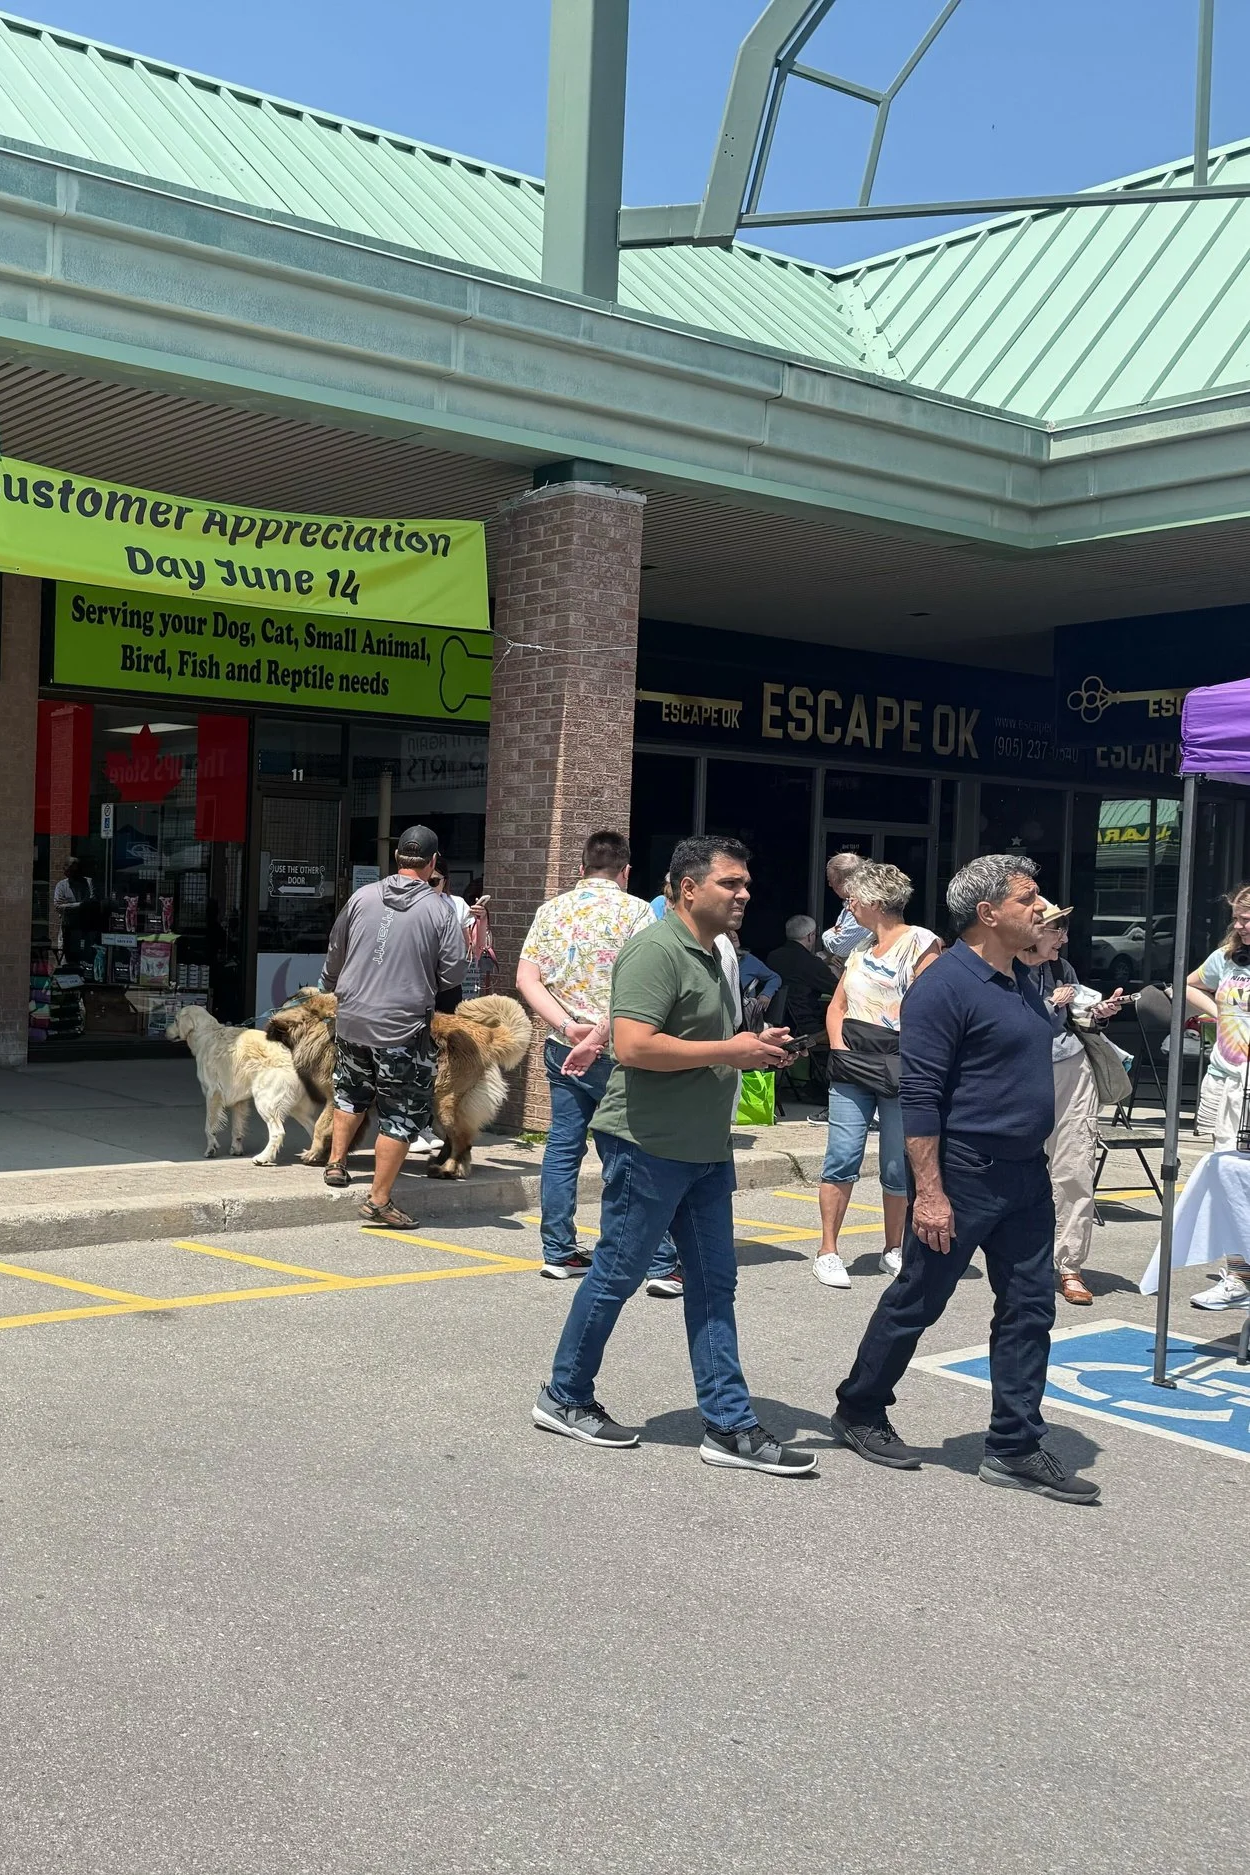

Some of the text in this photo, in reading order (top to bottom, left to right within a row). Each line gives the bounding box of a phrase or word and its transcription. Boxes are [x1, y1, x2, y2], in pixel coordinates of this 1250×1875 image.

[202, 507, 452, 559] Appreciation
[123, 545, 361, 605] Day June 14
[71, 595, 431, 666] Serving your Dog, Cat, Small Animal,
[121, 644, 389, 697] Bird, Fish and Reptile needs
[661, 700, 741, 729] ESCAPE OK
[761, 682, 982, 759] ESCAPE OK
[994, 736, 1023, 761] (905)
[1096, 743, 1180, 773] ESCAP
[291, 768, 304, 781] 11
[274, 865, 320, 875] USE THE OTHER
[287, 876, 306, 884] DOOR
